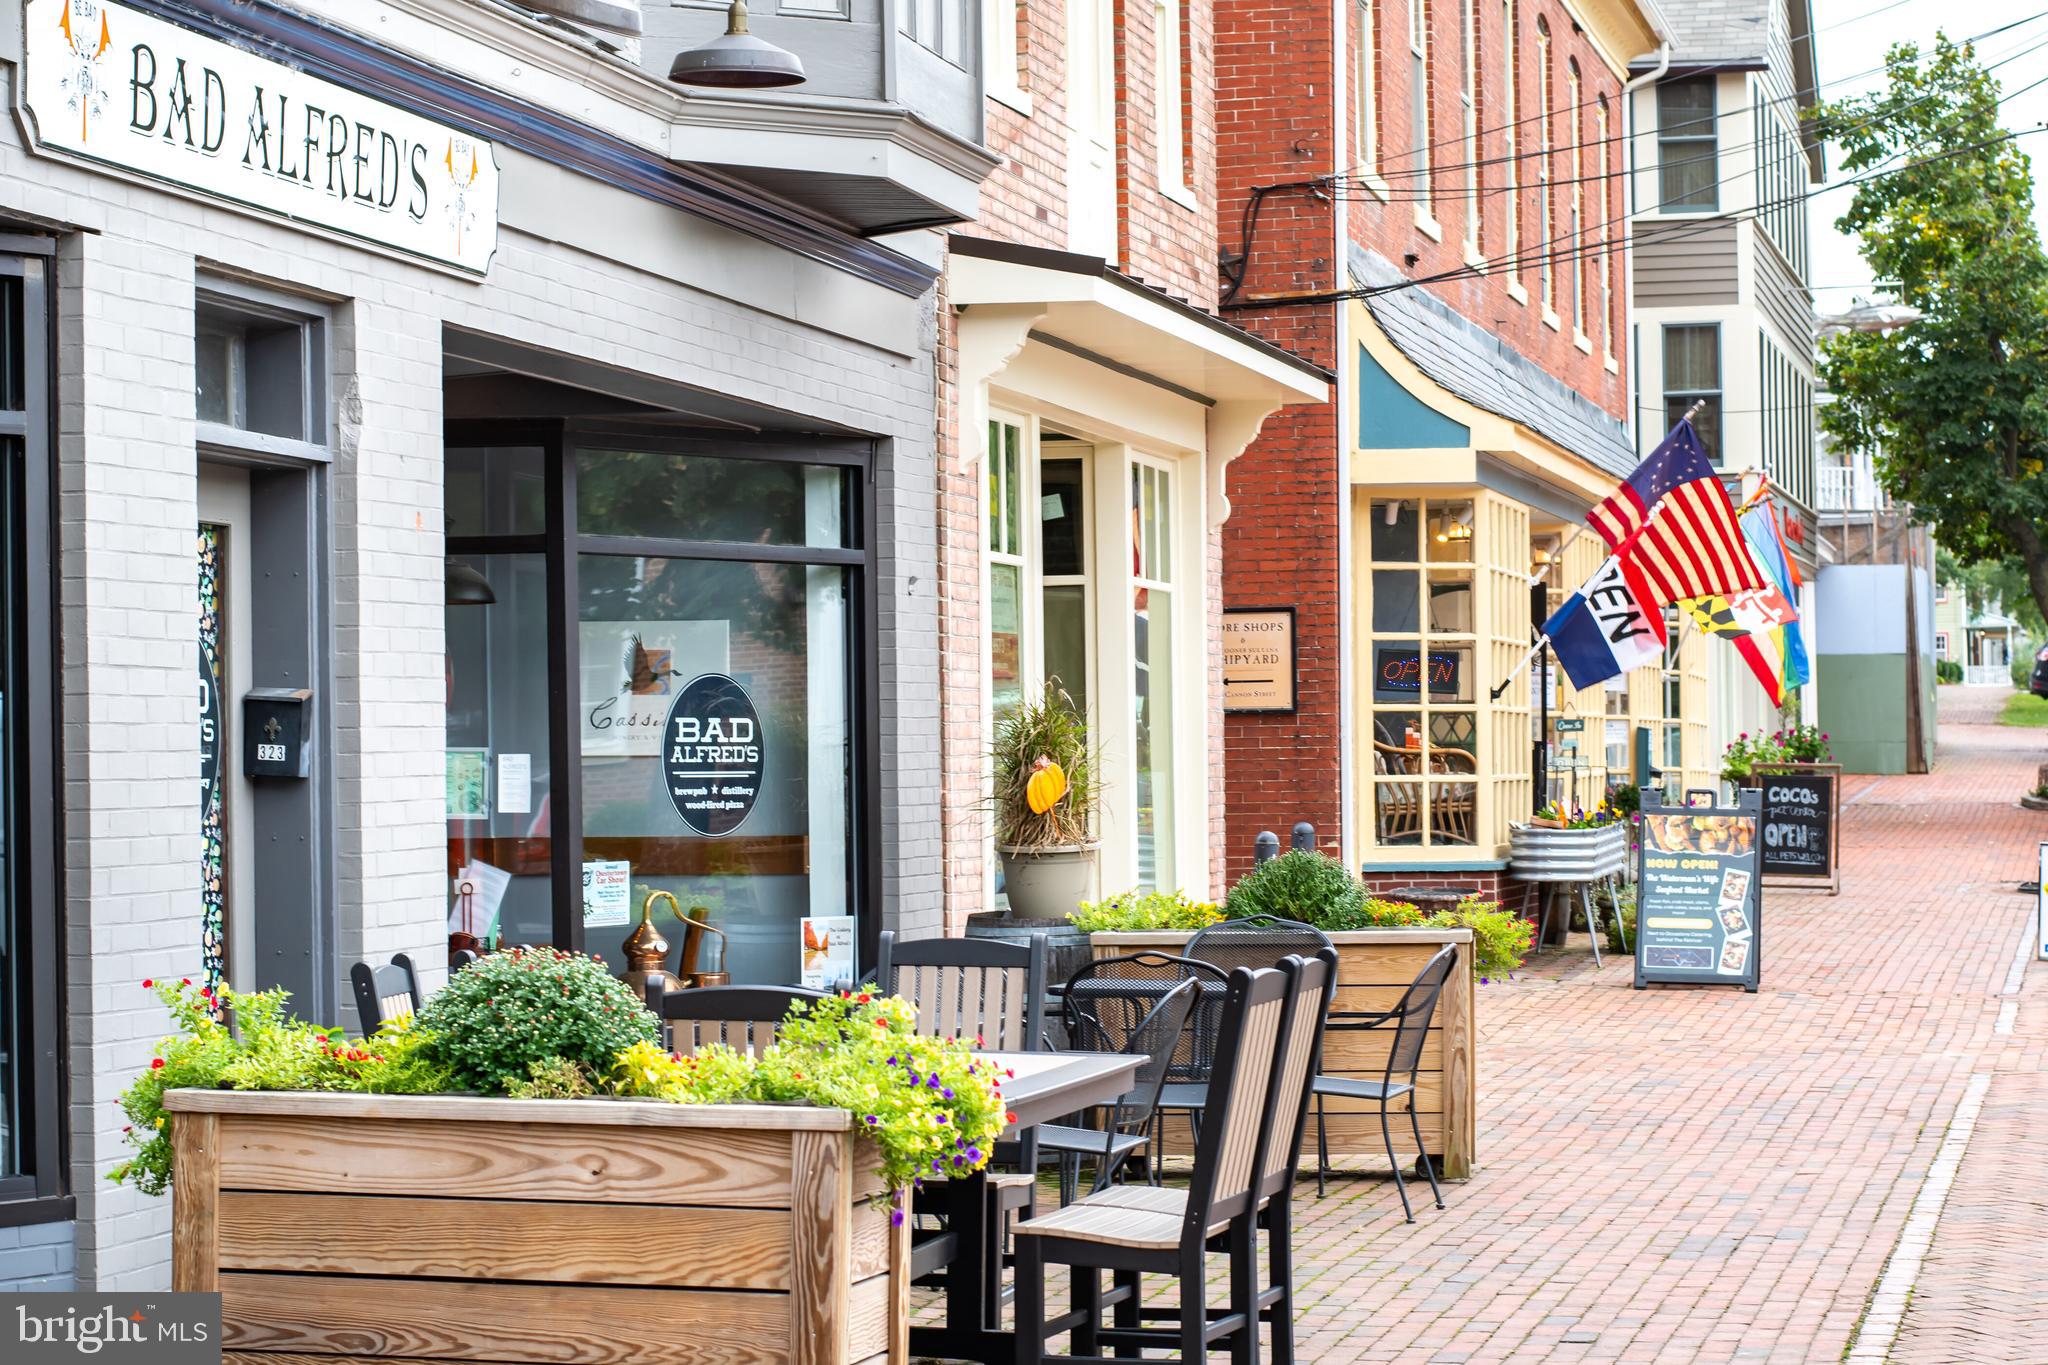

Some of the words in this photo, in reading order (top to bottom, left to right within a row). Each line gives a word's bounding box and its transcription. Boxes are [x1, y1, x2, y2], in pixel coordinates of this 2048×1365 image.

[130, 43, 226, 154] BAD
[241, 85, 428, 220] ALFRED'S
[1244, 623, 1284, 632] SHOPS
[1223, 654, 1280, 664] HIPYARD
[675, 717, 754, 743] BAD
[260, 745, 284, 760] 323
[670, 745, 759, 763] ALFRED'S
[674, 787, 708, 797] brewpub
[721, 786, 754, 796] distillery
[725, 801, 744, 810] pizza
[1764, 823, 1807, 848] OPEN
[1646, 858, 1678, 869] NOW
